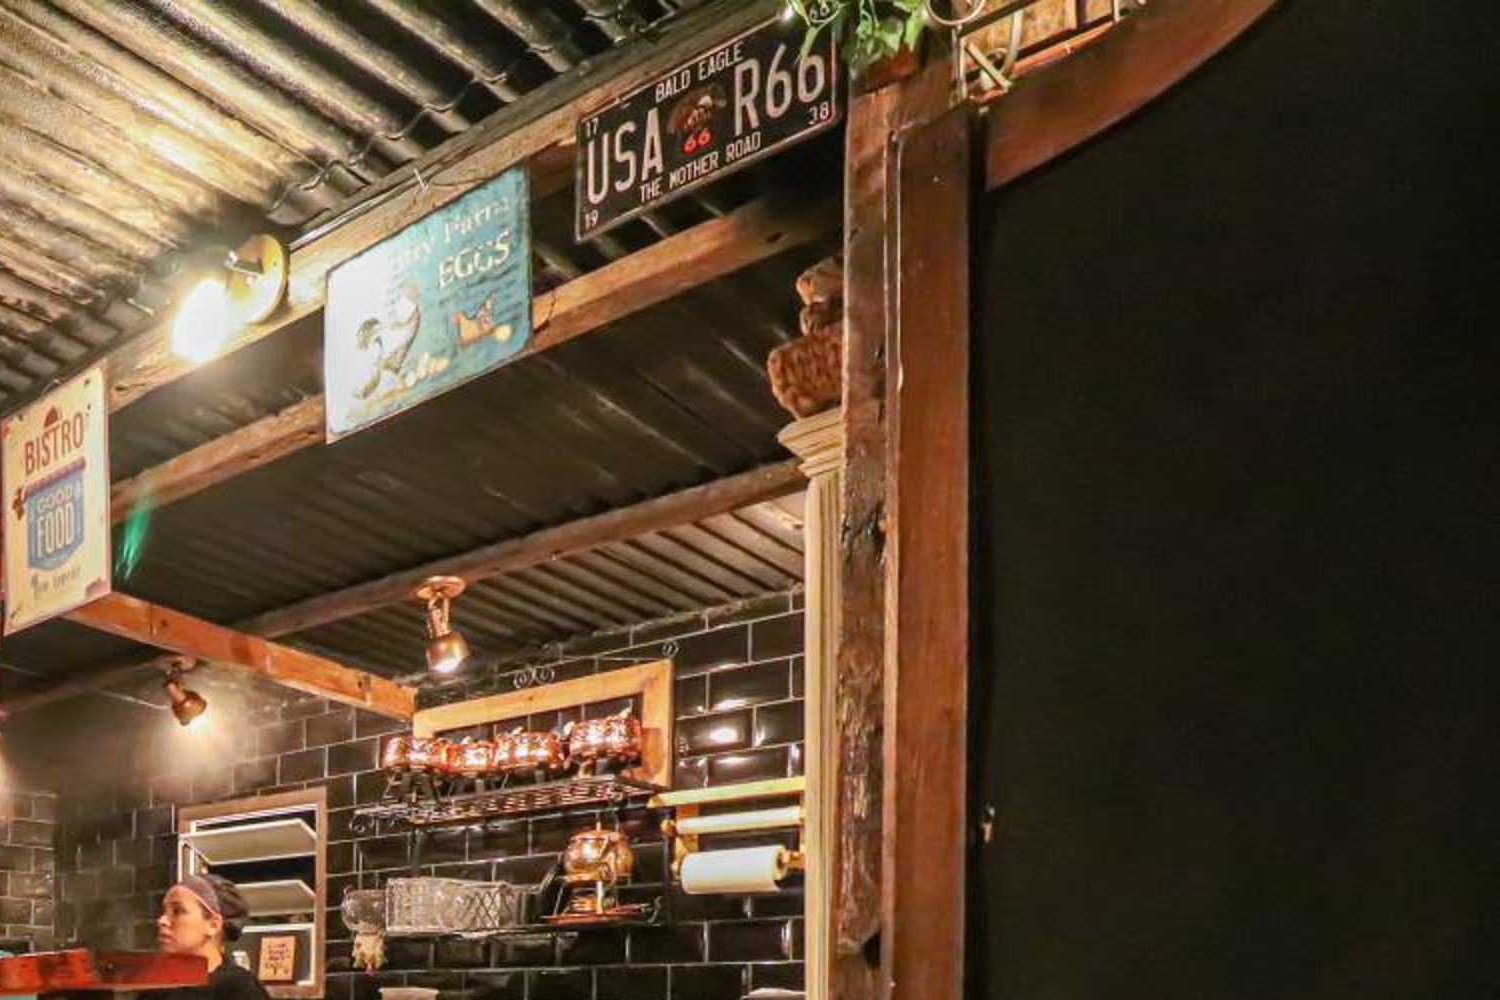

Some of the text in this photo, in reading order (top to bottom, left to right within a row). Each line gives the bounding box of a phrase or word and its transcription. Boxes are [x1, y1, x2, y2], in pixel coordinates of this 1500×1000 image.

[655, 43, 745, 103] BALD EAGLE
[735, 29, 825, 136] R66
[587, 107, 664, 205] USA
[640, 131, 761, 203] THE MOTHER ROAD
[25, 413, 84, 476] BISTRO
[36, 503, 75, 558] FOOD
